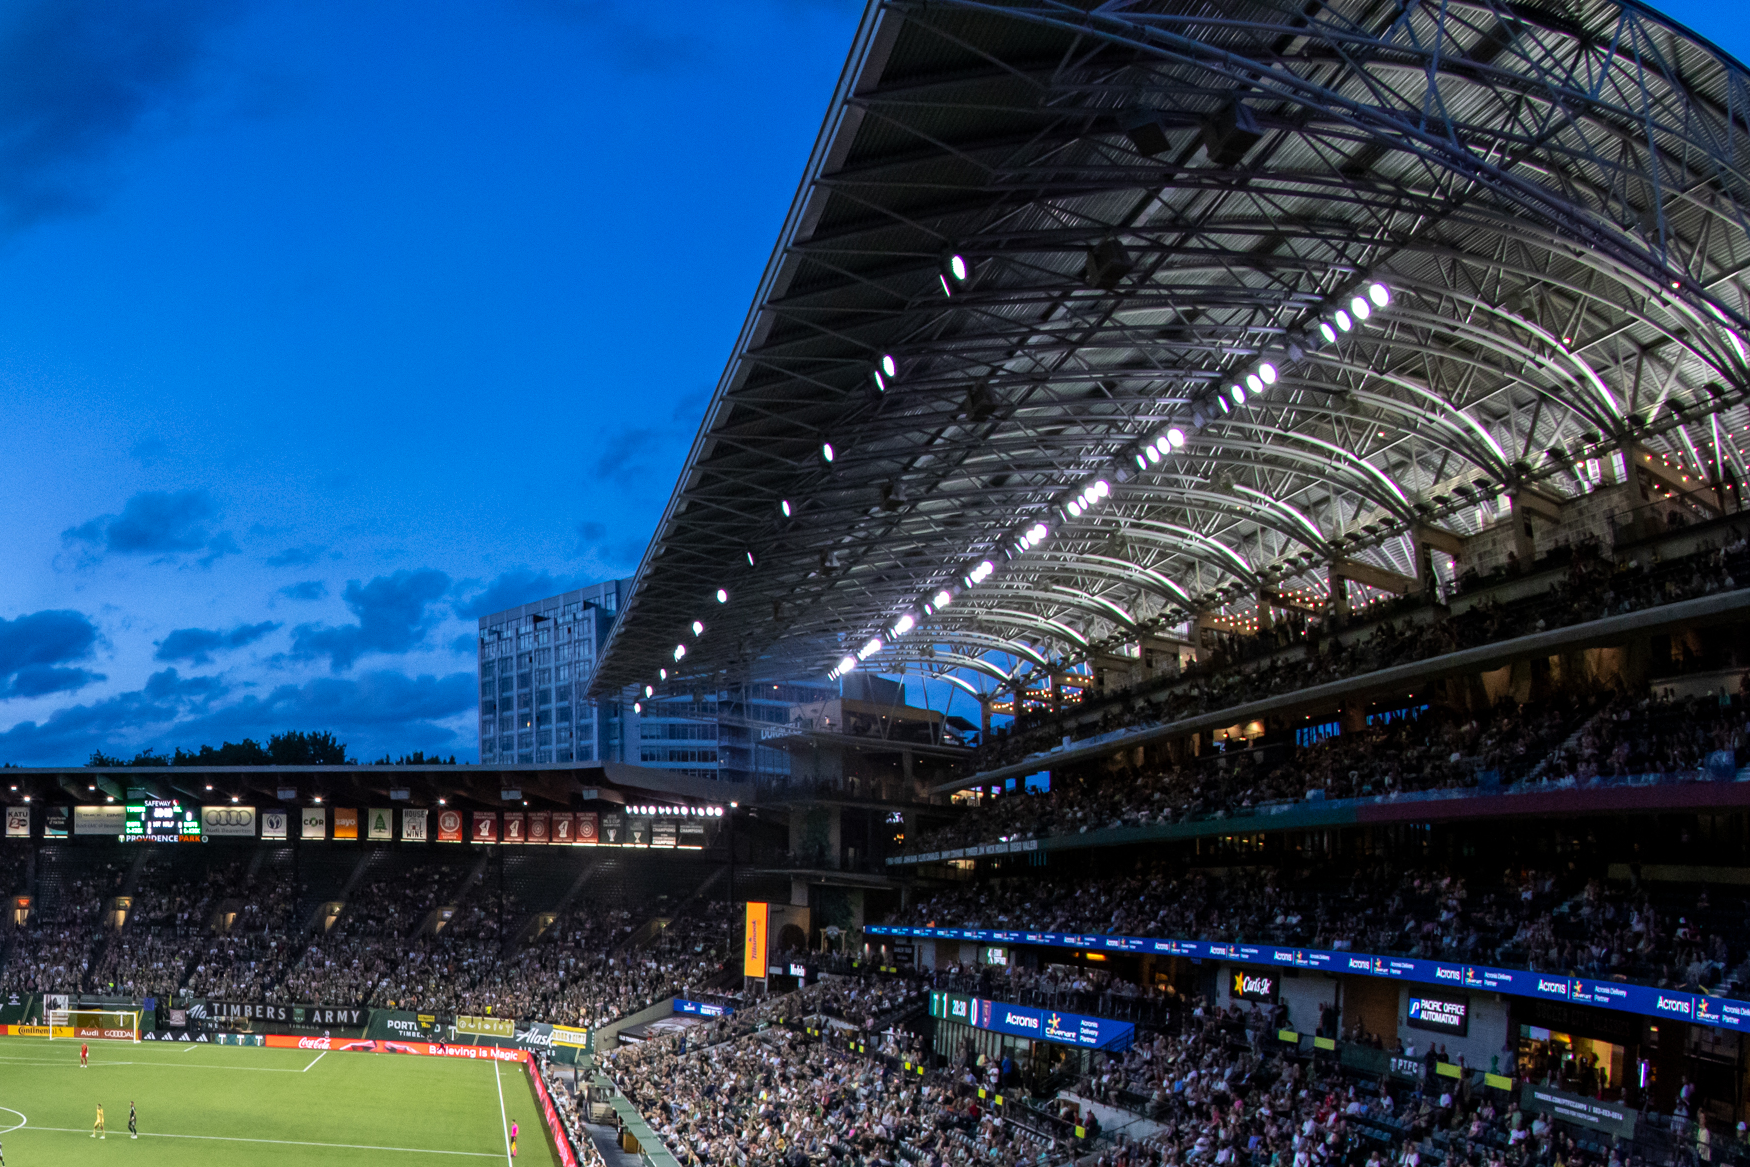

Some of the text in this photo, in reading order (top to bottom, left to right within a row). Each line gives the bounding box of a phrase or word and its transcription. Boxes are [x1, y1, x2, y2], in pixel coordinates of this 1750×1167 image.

[405, 810, 424, 818] HOUSE
[406, 830, 423, 838] WINE
[1209, 946, 1226, 956] Acronis
[1273, 951, 1293, 962] Acronis
[1348, 958, 1370, 970] Acronis
[1436, 966, 1460, 981] Acronis
[1243, 976, 1260, 993] Carl's
[1537, 979, 1567, 995] Acronis
[952, 999, 967, 1018] 20:38
[970, 997, 979, 1026] 0
[1420, 999, 1465, 1016] PACIFIC OFFICE
[1657, 995, 1691, 1014] Acronis
[212, 1003, 361, 1024] TIMBERS ARMY
[1005, 1012, 1039, 1029] Acronis
[1420, 1009, 1460, 1026] AUTOMATION
[387, 1019, 441, 1033] PORTLD
[1080, 1020, 1099, 1029] Acronis
[80, 1029, 99, 1037] Audi
[1080, 1027, 1099, 1037] Delivery
[298, 1036, 331, 1050] Coca-Cola
[1079, 1035, 1097, 1044] Partner
[490, 1049, 518, 1061] Magic
[1398, 1059, 1418, 1075] PTFC
